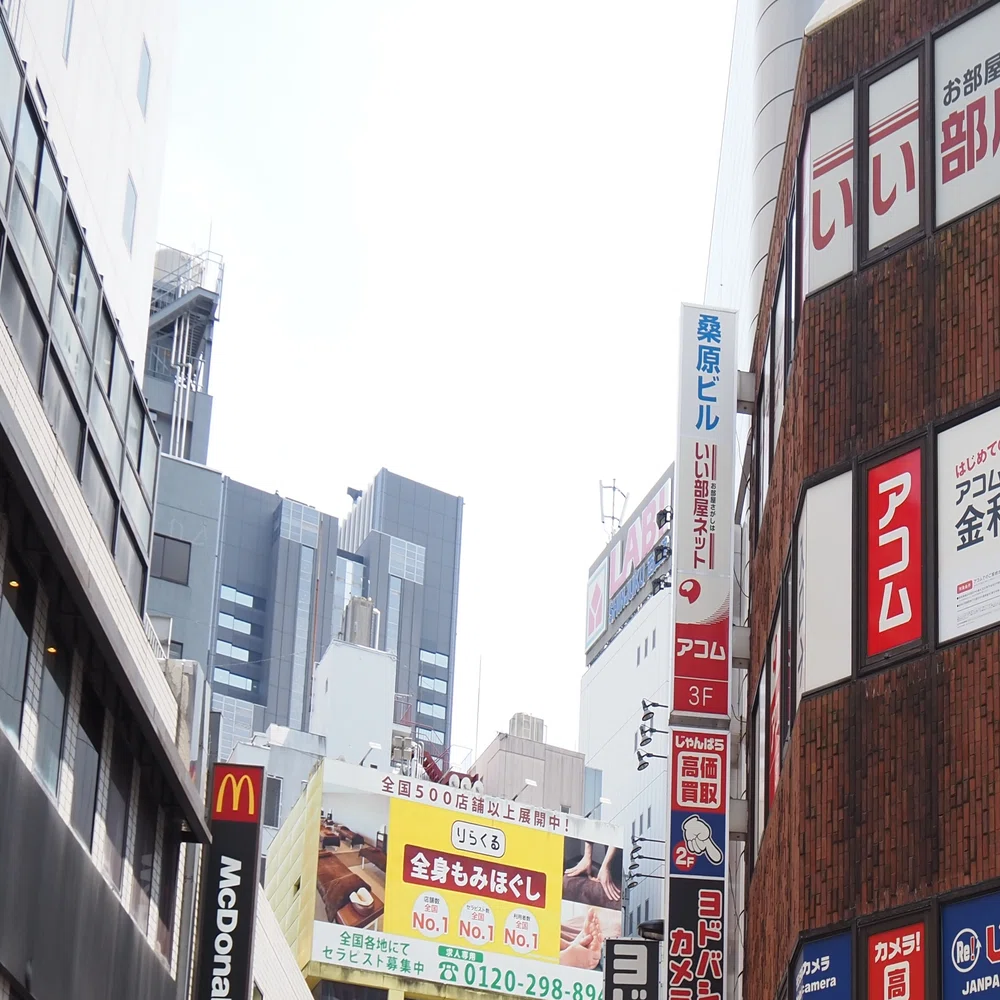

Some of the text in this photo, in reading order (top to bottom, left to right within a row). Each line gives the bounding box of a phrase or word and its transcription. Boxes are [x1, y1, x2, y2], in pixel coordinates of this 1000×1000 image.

[696, 314, 721, 431] 桑原ビル
[693, 442, 710, 569] いい部屋ネット
[709, 483, 717, 532] お部屋さがしは
[878, 471, 912, 633] アコム
[677, 638, 726, 661] アコム
[688, 685, 713, 707] 3F
[681, 756, 718, 779] 高価
[681, 781, 718, 804] 買取
[457, 826, 500, 851] りらくる
[676, 846, 695, 868] 2F
[410, 852, 540, 900] 全身もみほぐし
[424, 904, 438, 913] 全国
[471, 912, 484, 921] 全国
[413, 911, 448, 933] No.1
[460, 920, 494, 941] No.1
[515, 921, 528, 930] 全国
[340, 931, 410, 956] 全国各地にて
[505, 928, 538, 949] No.1
[875, 930, 921, 963] カメラ!
[323, 947, 424, 974] セラピスト募集中
[446, 948, 476, 961] 求人専用
